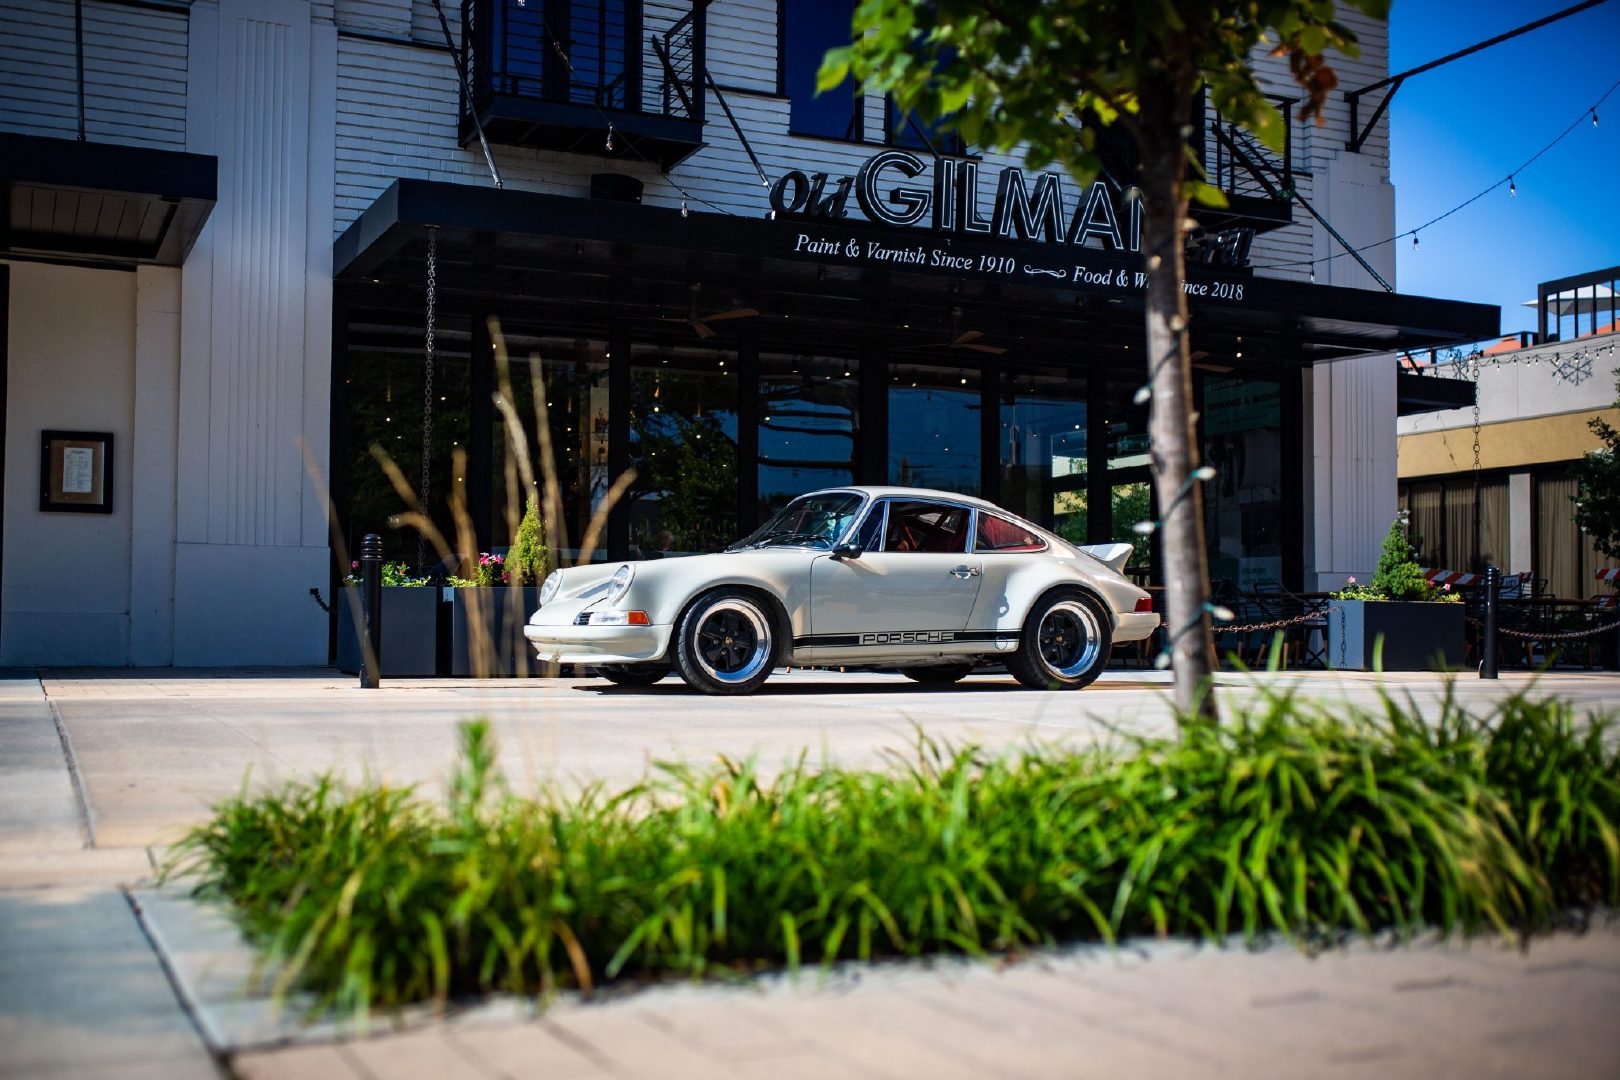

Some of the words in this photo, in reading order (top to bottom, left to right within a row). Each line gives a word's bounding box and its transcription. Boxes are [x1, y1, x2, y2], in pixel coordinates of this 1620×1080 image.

[771, 171, 855, 218] Old
[794, 233, 841, 255] Paint
[845, 238, 860, 258] &
[867, 241, 927, 264] Varnish
[931, 249, 973, 270] Since
[977, 255, 1015, 274] 1910
[1073, 265, 1113, 286] Food
[1116, 269, 1129, 288] &
[1179, 279, 1208, 296] ince
[1211, 281, 1244, 301] 2018
[862, 631, 954, 644] PORSCHE
